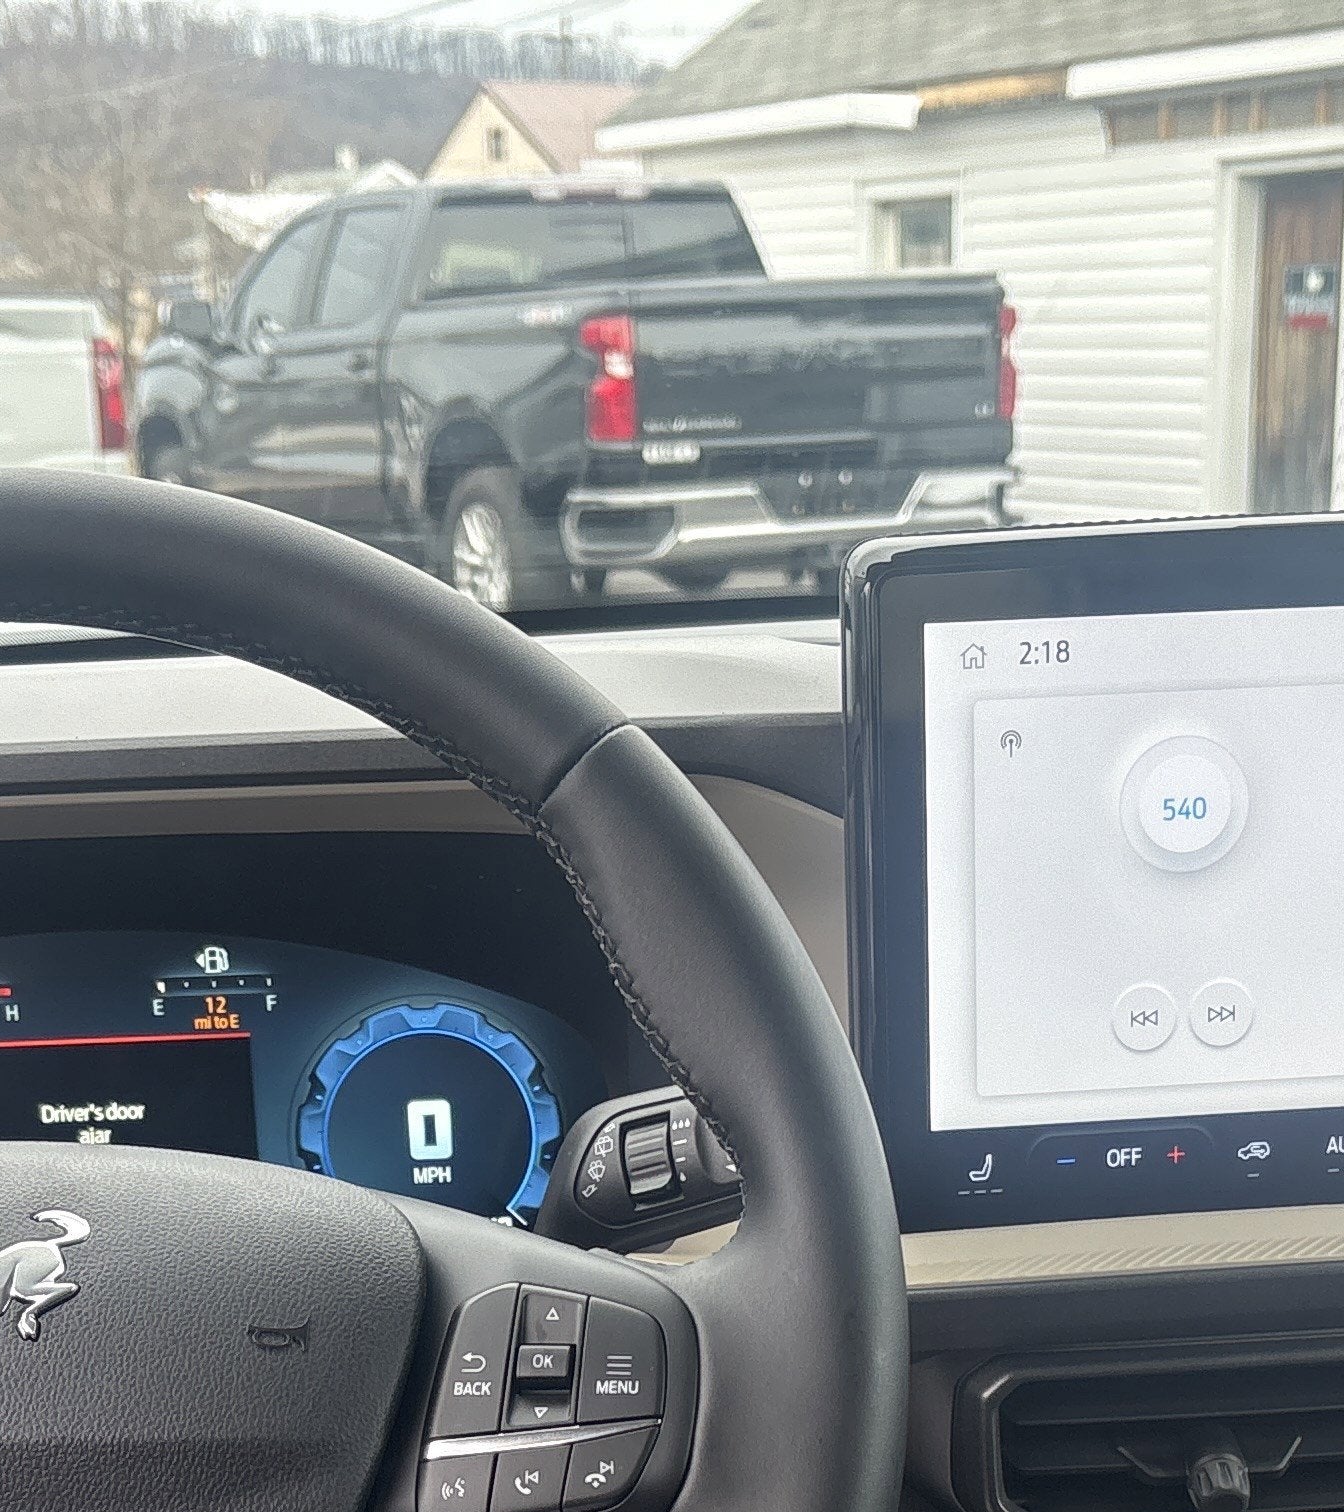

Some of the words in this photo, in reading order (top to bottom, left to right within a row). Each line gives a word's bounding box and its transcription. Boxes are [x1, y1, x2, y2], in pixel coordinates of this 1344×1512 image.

[1019, 640, 1071, 666] 2:18
[1162, 796, 1208, 822] 540
[152, 998, 165, 1016] E
[205, 996, 227, 1014] 12
[265, 994, 277, 1012] F
[5, 1004, 20, 1022] H
[194, 1015, 212, 1030] mi
[213, 1015, 228, 1029] to
[229, 1013, 240, 1029] E
[40, 1103, 104, 1124] Driver's
[105, 1101, 146, 1121] door
[78, 1126, 112, 1144] ajar
[407, 1099, 454, 1160] 0
[1105, 1146, 1143, 1169] OFF
[413, 1166, 452, 1184] MPH
[532, 1353, 554, 1369] OK
[453, 1381, 492, 1396] BACK
[595, 1380, 640, 1395] MENU
